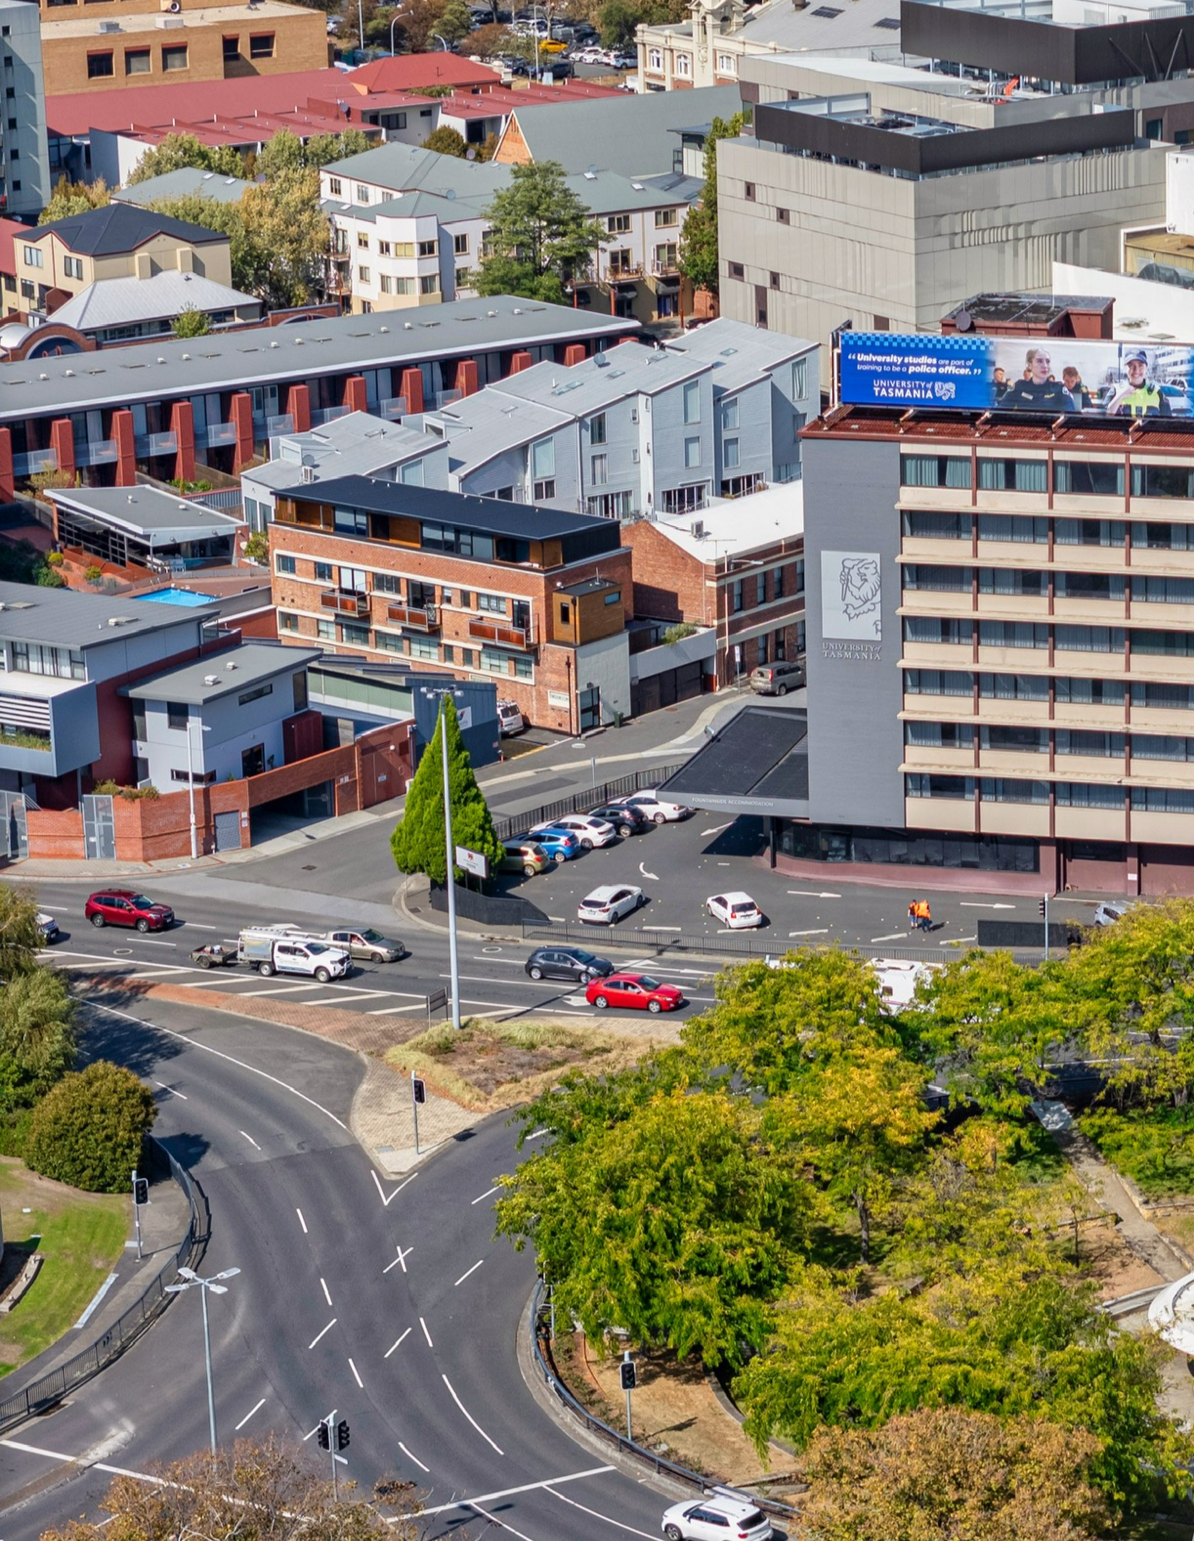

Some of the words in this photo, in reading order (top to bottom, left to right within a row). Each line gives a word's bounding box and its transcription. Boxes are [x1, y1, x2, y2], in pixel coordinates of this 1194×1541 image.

[904, 354, 937, 364] studies
[857, 364, 882, 372] training
[908, 365, 936, 374] police
[873, 379, 925, 389] UNIVERSITY
[873, 387, 933, 399] TASMANIA
[822, 642, 875, 652] UNIVERSITY
[822, 650, 882, 661] TASMANIA
[728, 798, 774, 807] ACCOMMODATION
